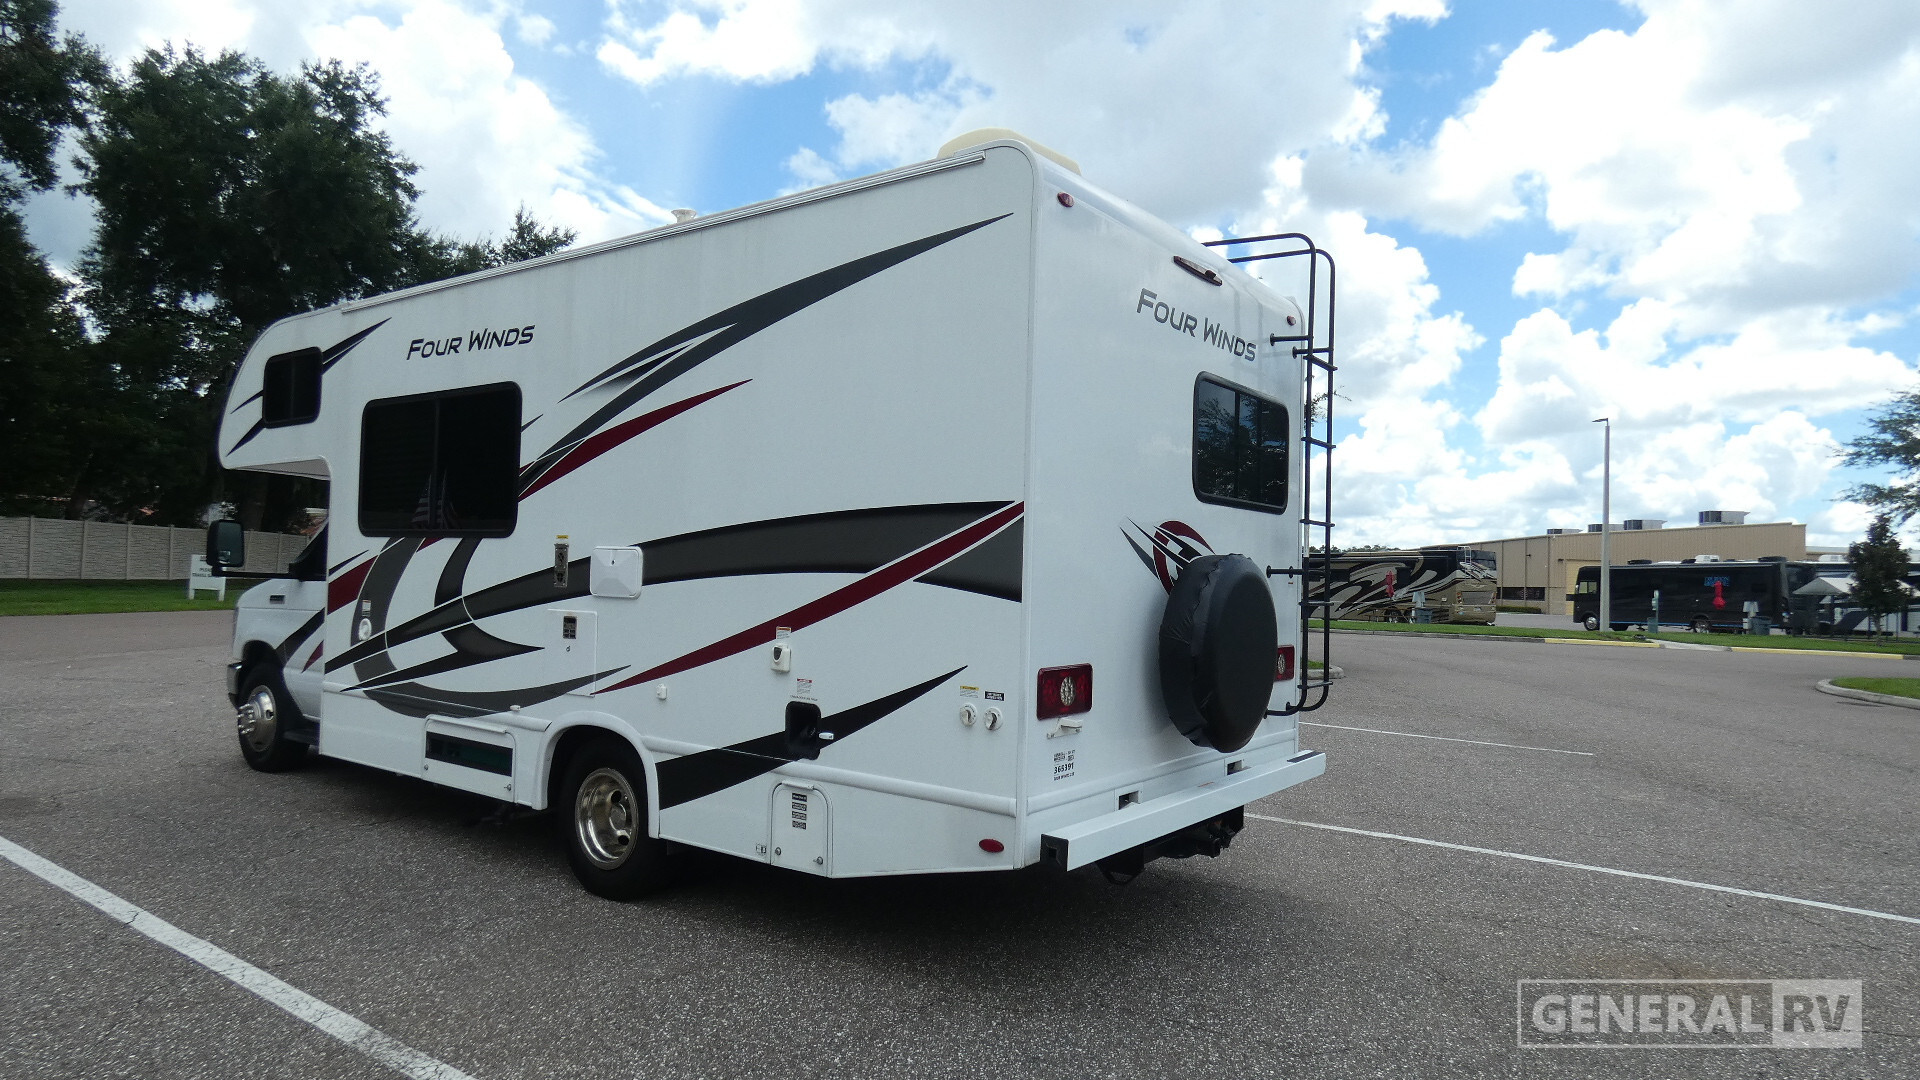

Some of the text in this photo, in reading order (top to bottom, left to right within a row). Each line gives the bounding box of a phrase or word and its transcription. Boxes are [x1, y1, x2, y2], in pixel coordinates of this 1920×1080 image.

[406, 324, 536, 361] FOUR WINDS
[1136, 287, 1257, 362] FOUR WINDS
